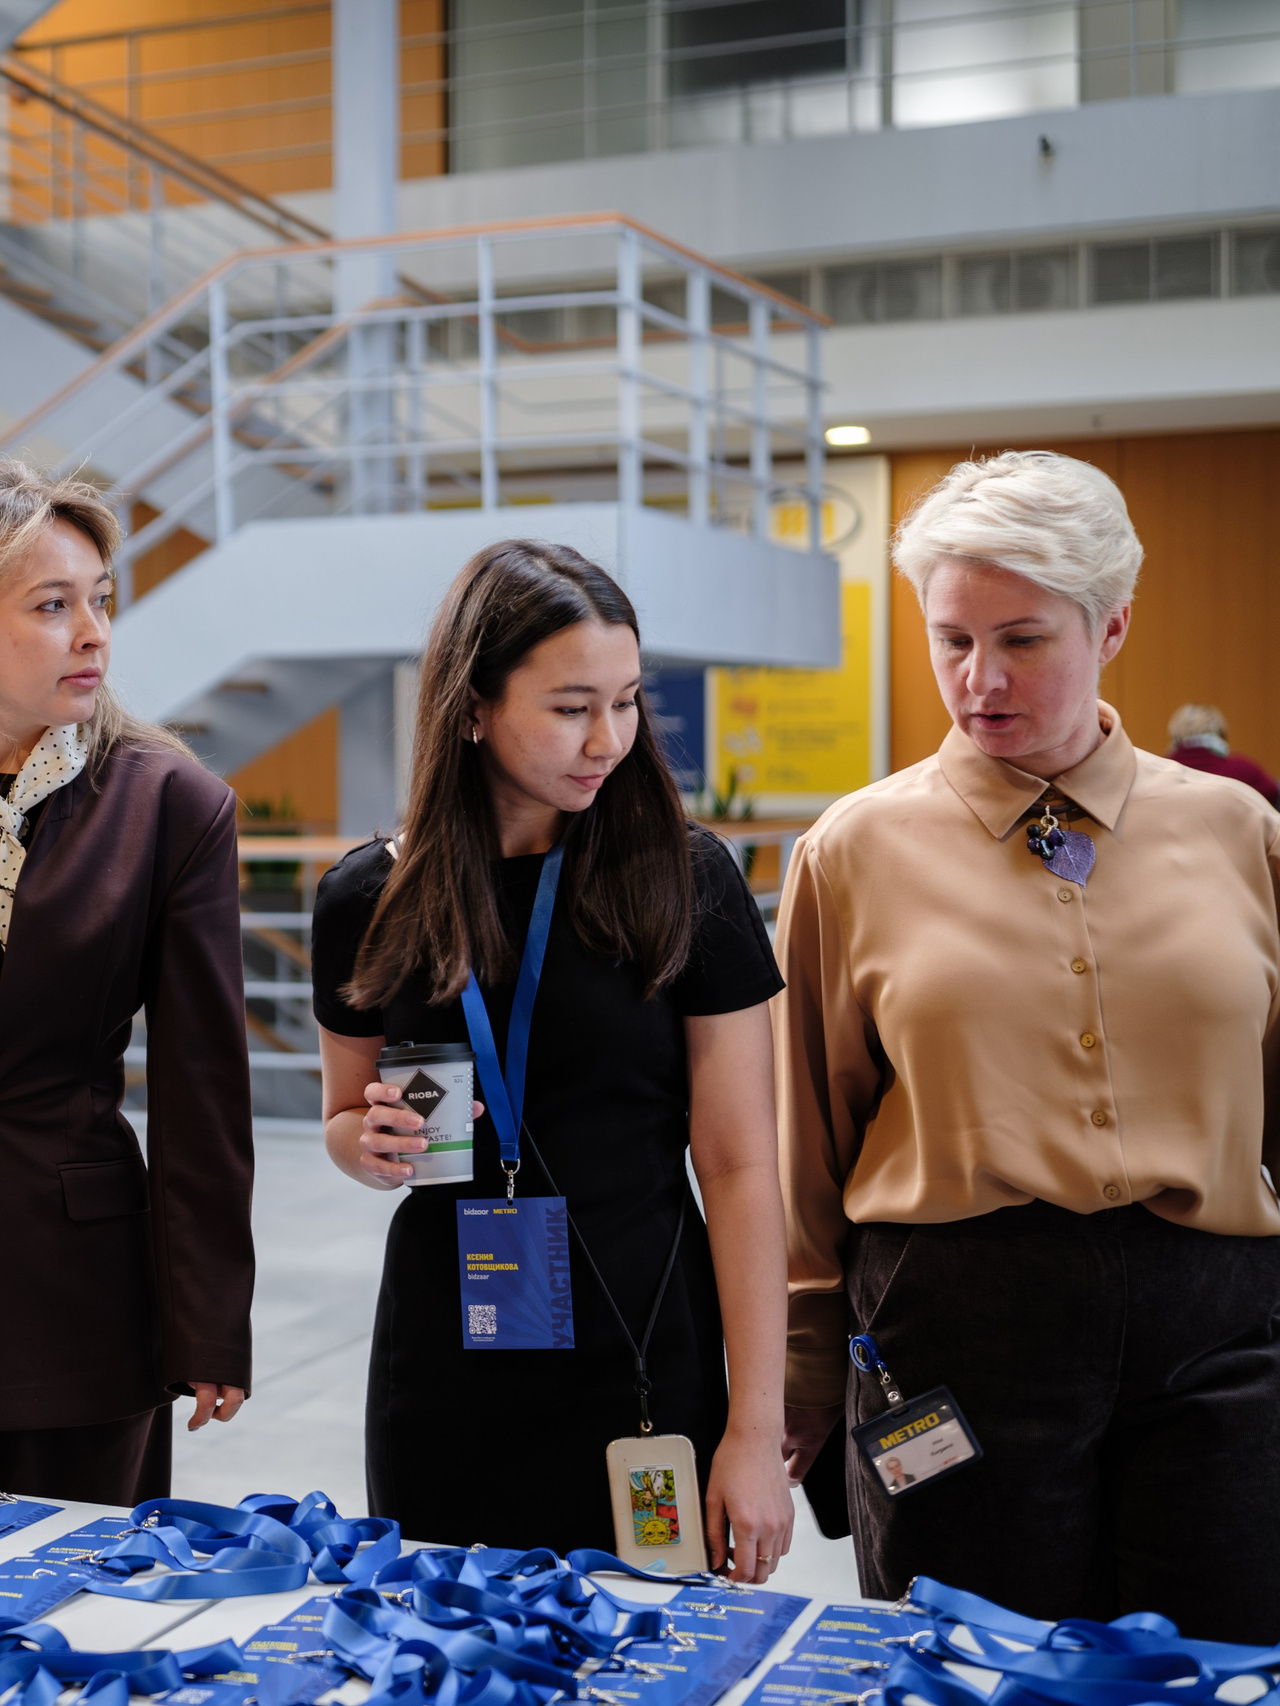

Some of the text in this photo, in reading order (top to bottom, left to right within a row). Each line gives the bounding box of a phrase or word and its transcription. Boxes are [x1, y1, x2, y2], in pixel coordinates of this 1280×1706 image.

[408, 1090, 439, 1100] RIOBA
[466, 1253, 494, 1261] КСЕНИЯ
[546, 1206, 574, 1348] УЧАСТНИК
[878, 1411, 941, 1450] METRO
